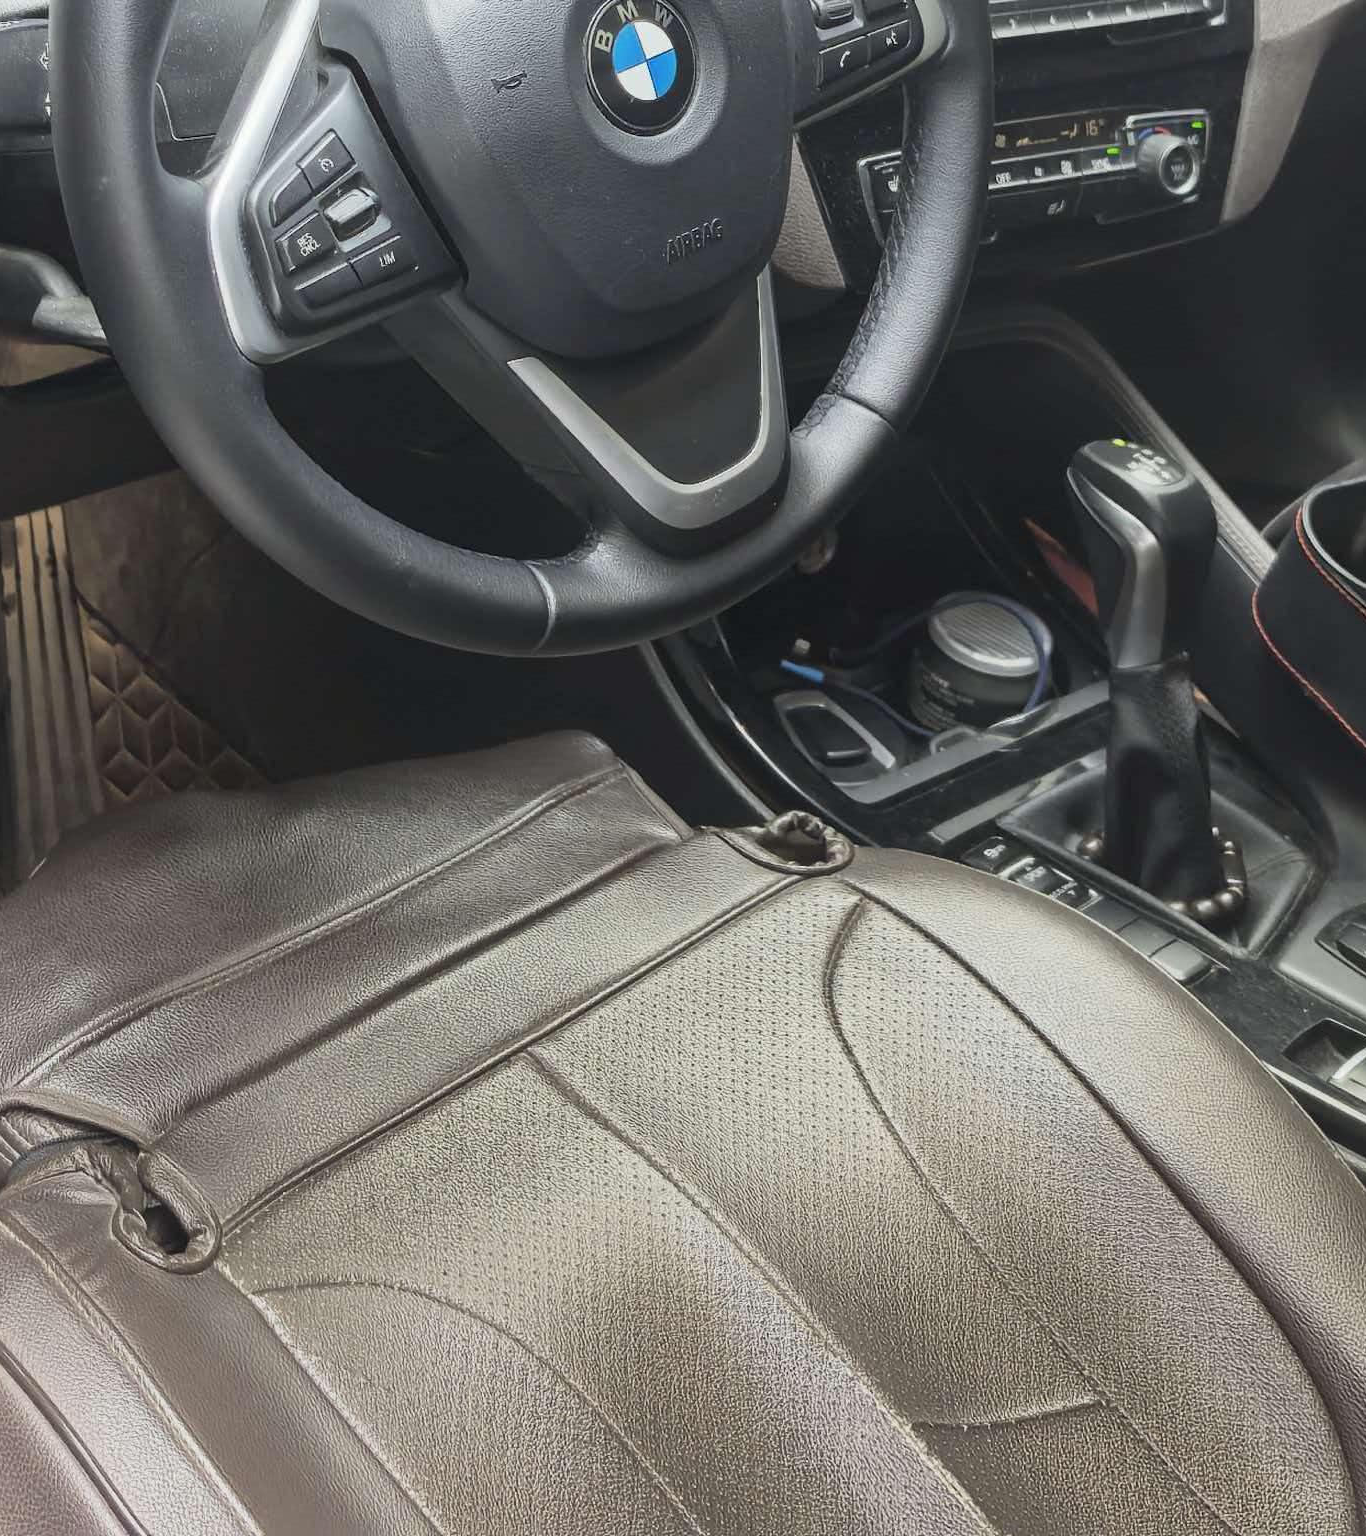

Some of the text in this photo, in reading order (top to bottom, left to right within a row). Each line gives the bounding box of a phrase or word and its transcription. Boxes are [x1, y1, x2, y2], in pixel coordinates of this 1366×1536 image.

[594, 0, 675, 55] BMW
[995, 172, 1011, 185] OFF
[296, 232, 314, 248] RES
[666, 217, 723, 265] AIRBAG
[379, 251, 396, 267] LIM
